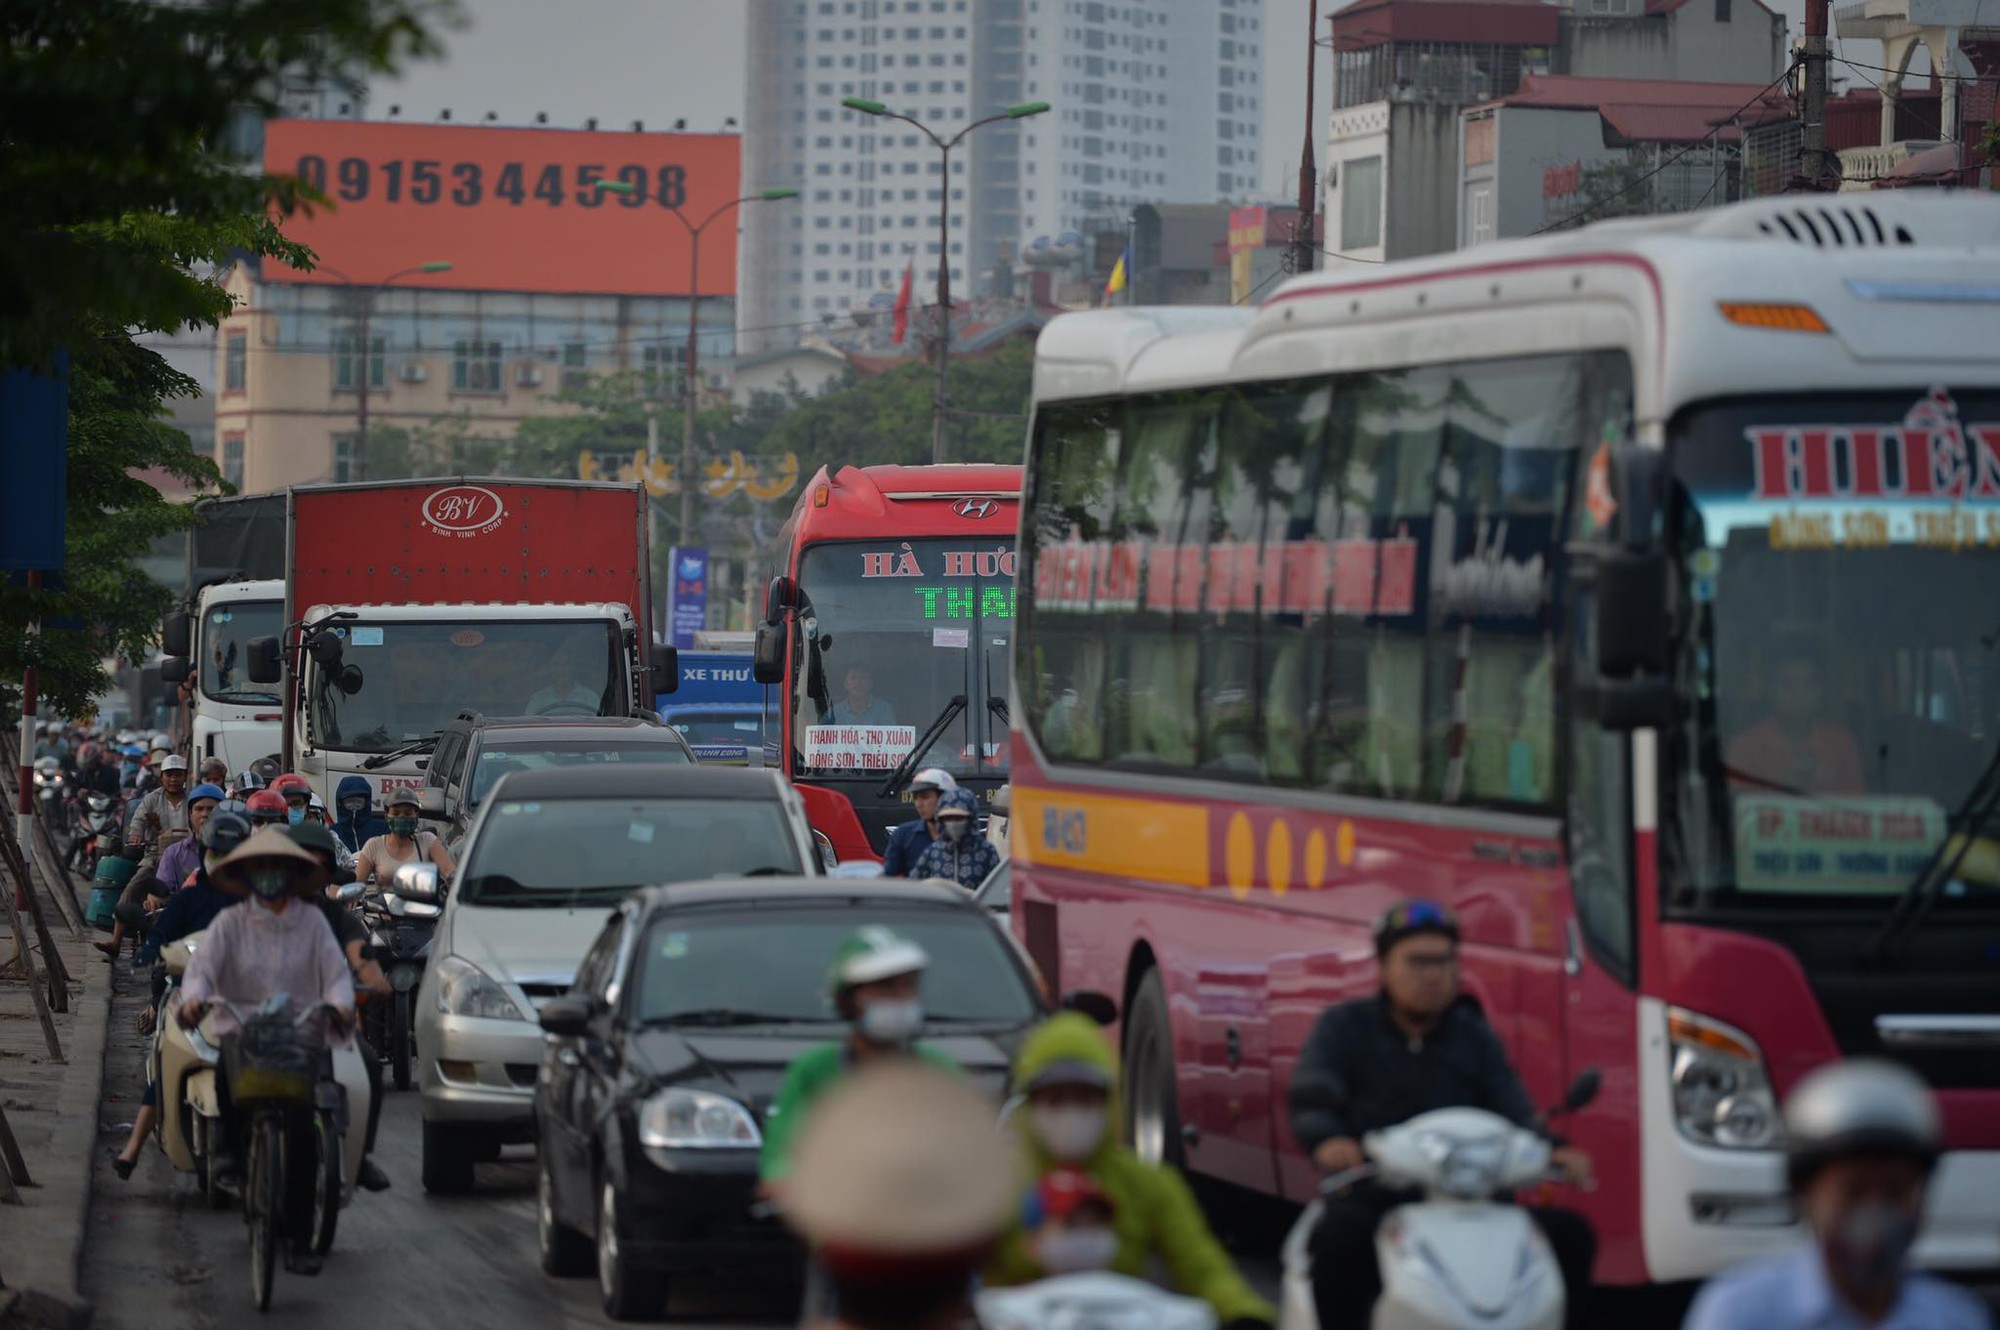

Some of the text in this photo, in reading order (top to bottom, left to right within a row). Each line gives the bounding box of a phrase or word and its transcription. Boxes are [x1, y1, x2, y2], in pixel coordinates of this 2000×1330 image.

[296, 155, 687, 209] 0915344598
[436, 495, 486, 520] BV
[482, 517, 502, 534] CORP
[861, 542, 925, 577] HÀ
[914, 587, 1017, 618] THA
[683, 668, 707, 680] XE
[709, 667, 750, 681] THƯ
[809, 730, 838, 744] THANH
[840, 726, 859, 744] HÓA
[886, 728, 912, 745] XUÂN
